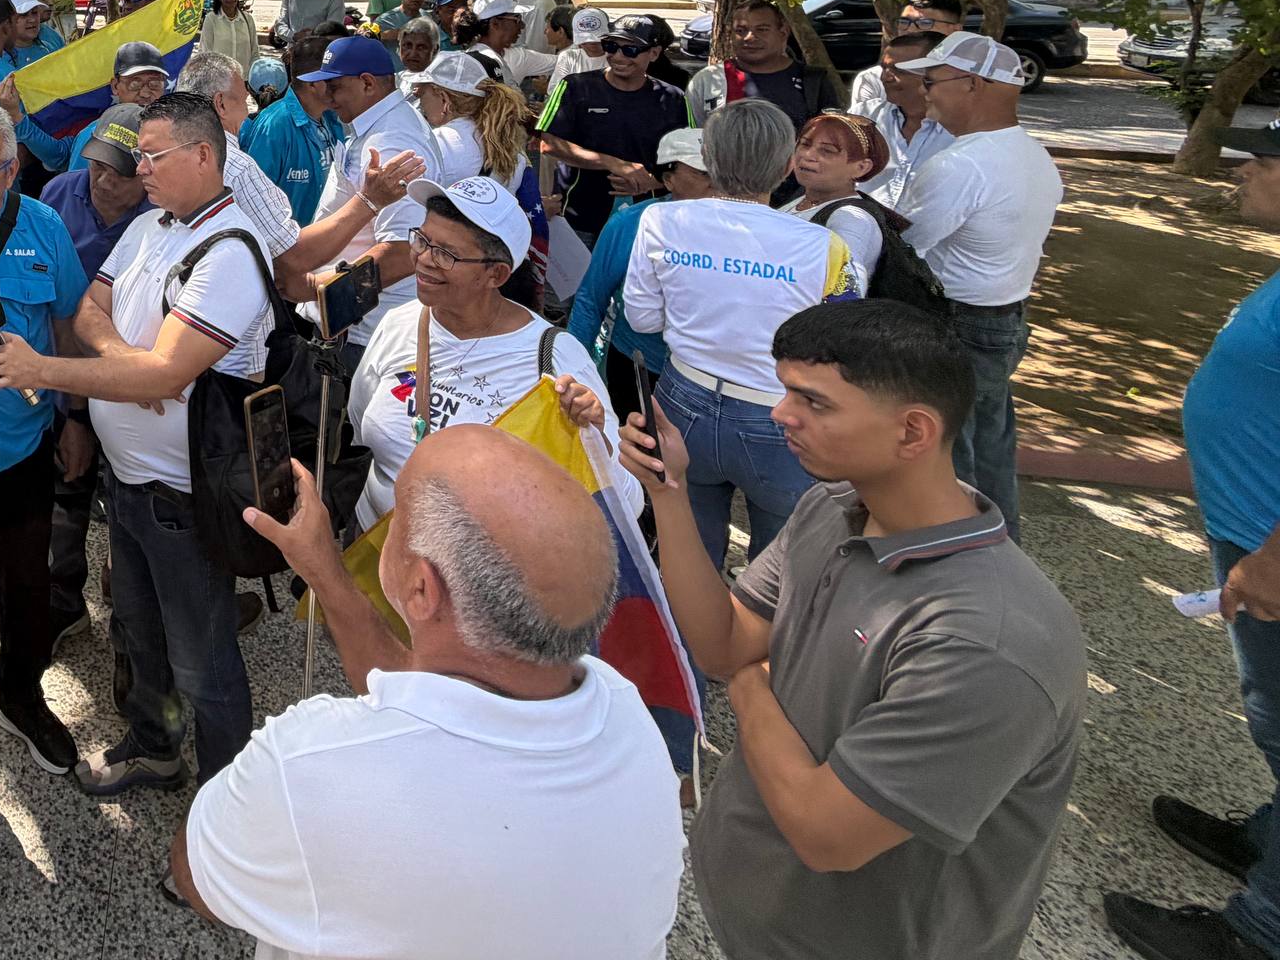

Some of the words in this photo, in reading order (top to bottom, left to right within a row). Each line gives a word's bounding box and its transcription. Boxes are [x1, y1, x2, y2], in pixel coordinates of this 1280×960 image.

[5, 248, 12, 256] A.
[14, 248, 36, 256] SALAS
[663, 248, 717, 270] COORD.
[723, 258, 797, 282] ESTADAL
[429, 392, 460, 417] ON
[430, 379, 484, 406] luntarios
